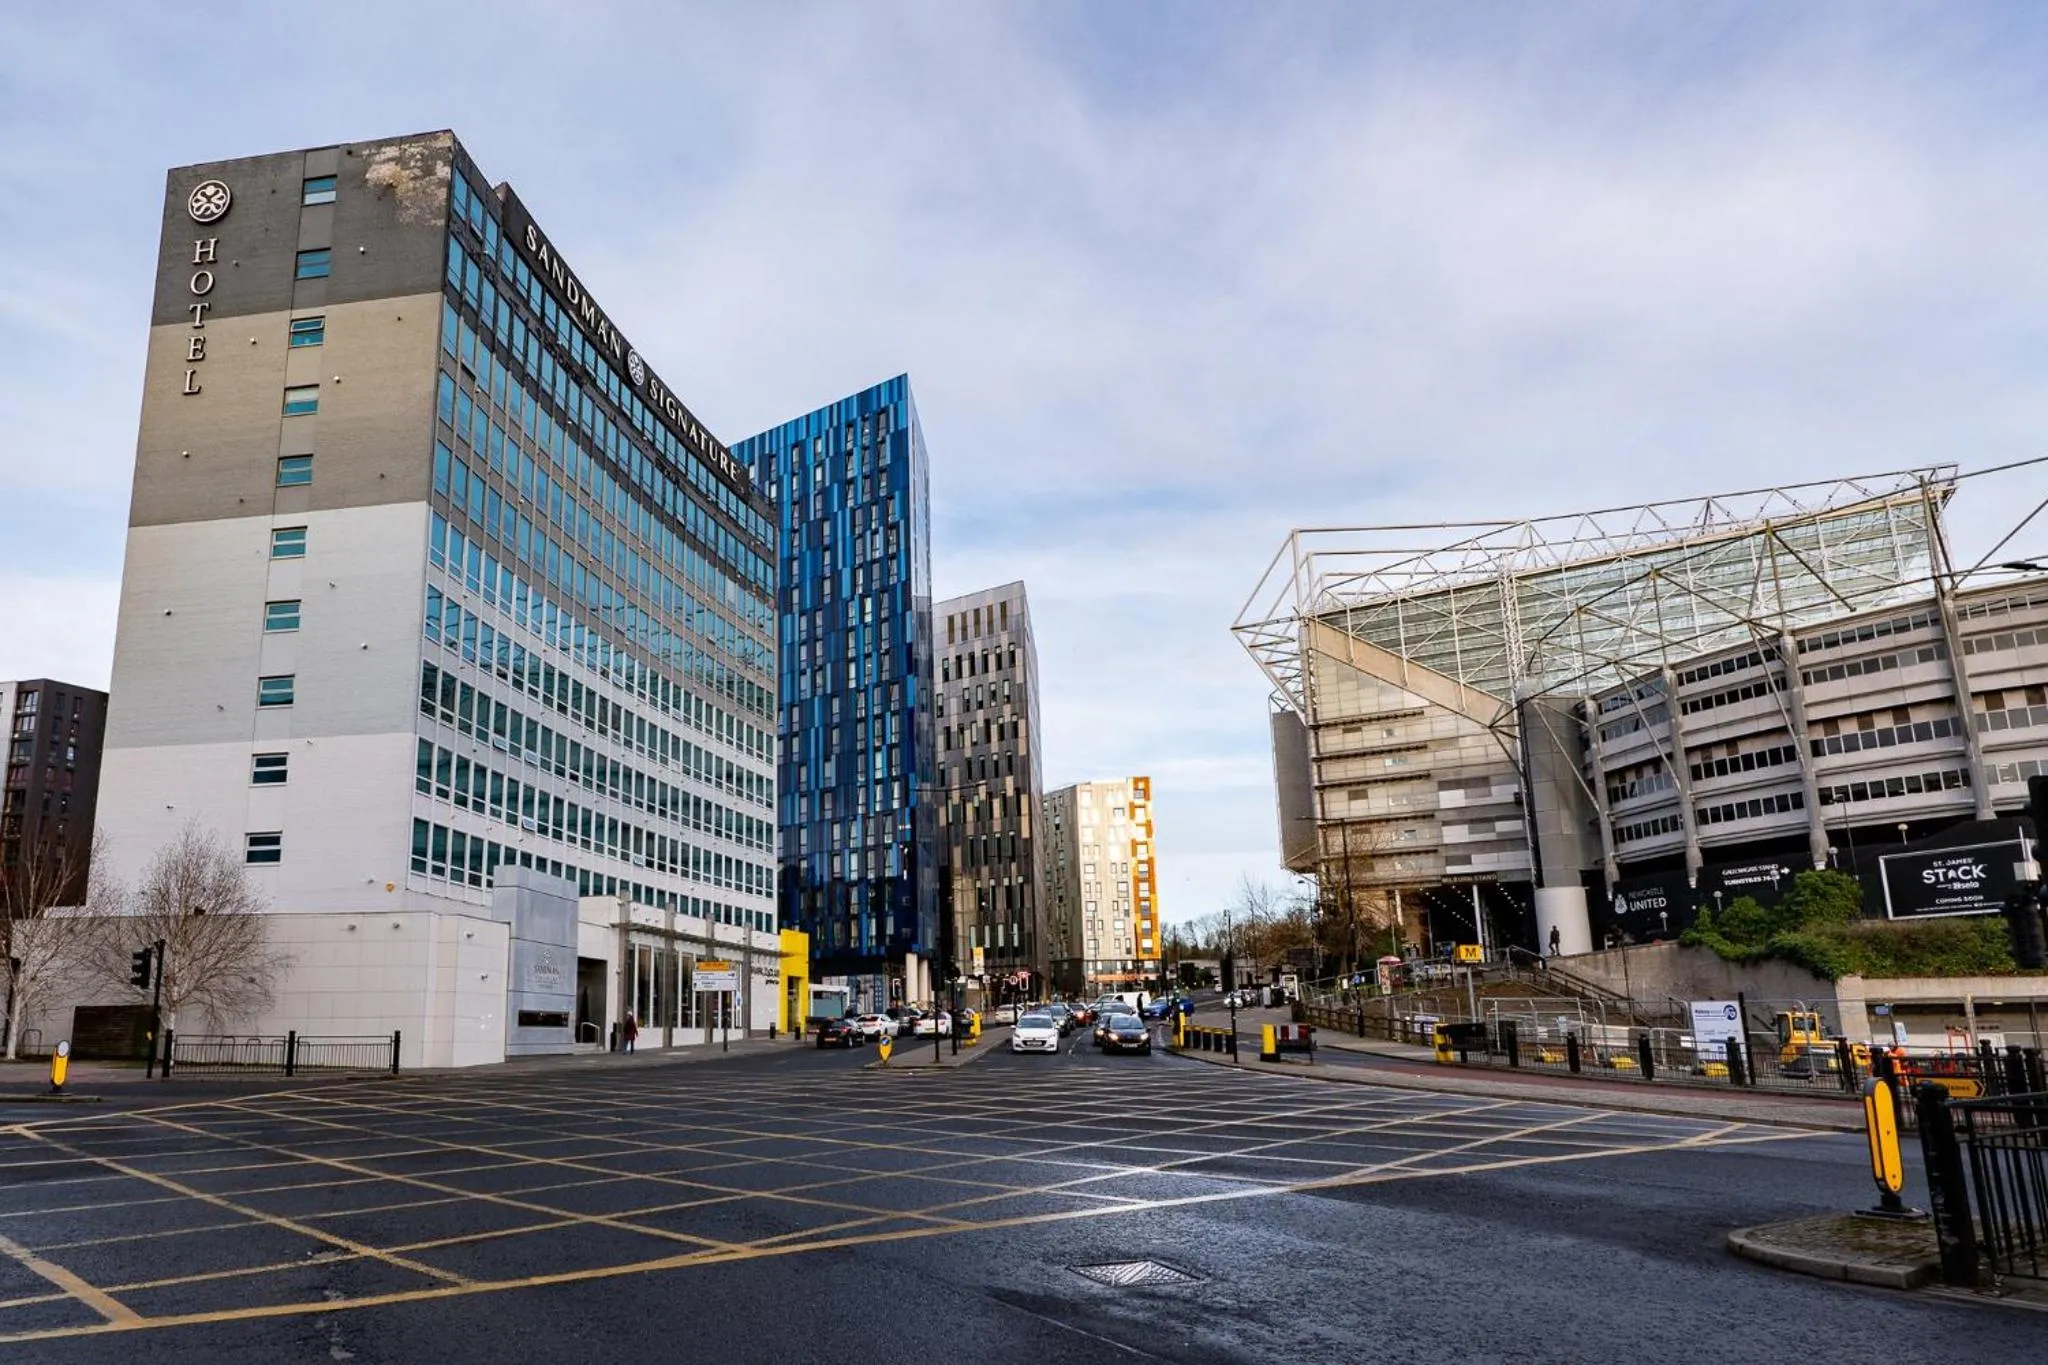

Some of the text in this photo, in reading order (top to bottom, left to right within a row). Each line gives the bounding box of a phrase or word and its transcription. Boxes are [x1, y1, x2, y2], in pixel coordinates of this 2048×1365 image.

[183, 238, 219, 395] HOTEL
[526, 224, 738, 483] SANDMAN SIGNATURE
[1629, 897, 1667, 912] UNITED
[1464, 947, 1477, 958] M
